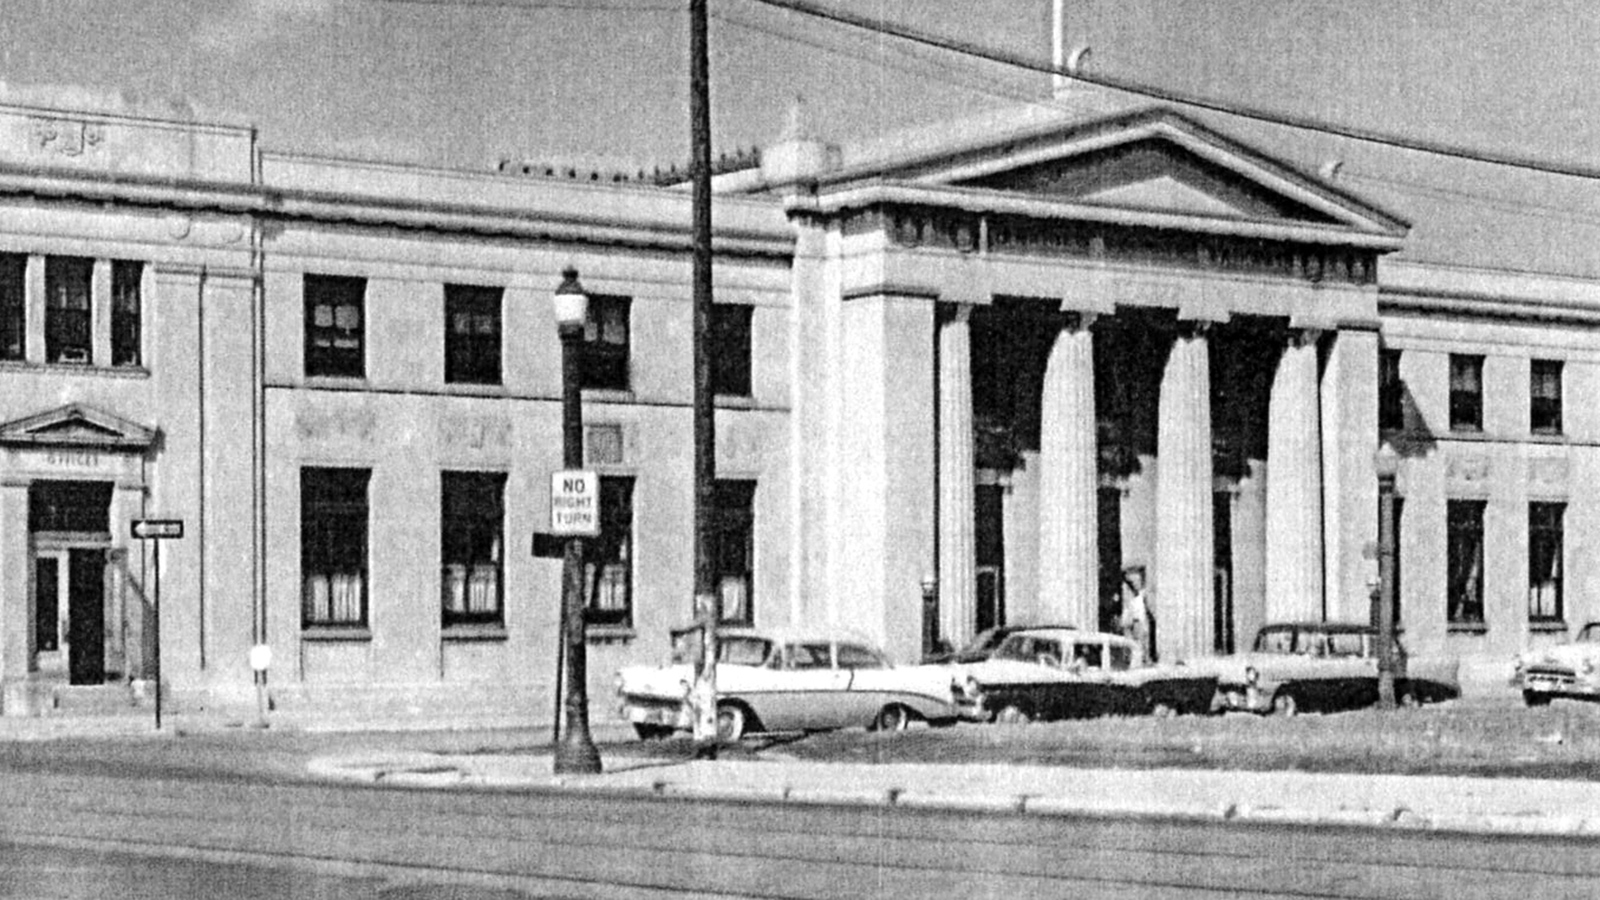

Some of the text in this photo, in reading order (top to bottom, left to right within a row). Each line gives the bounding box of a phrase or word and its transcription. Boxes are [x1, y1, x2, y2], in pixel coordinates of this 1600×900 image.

[563, 479, 585, 493] NO
[554, 497, 592, 508] RIGHT
[556, 512, 592, 524] TURN
